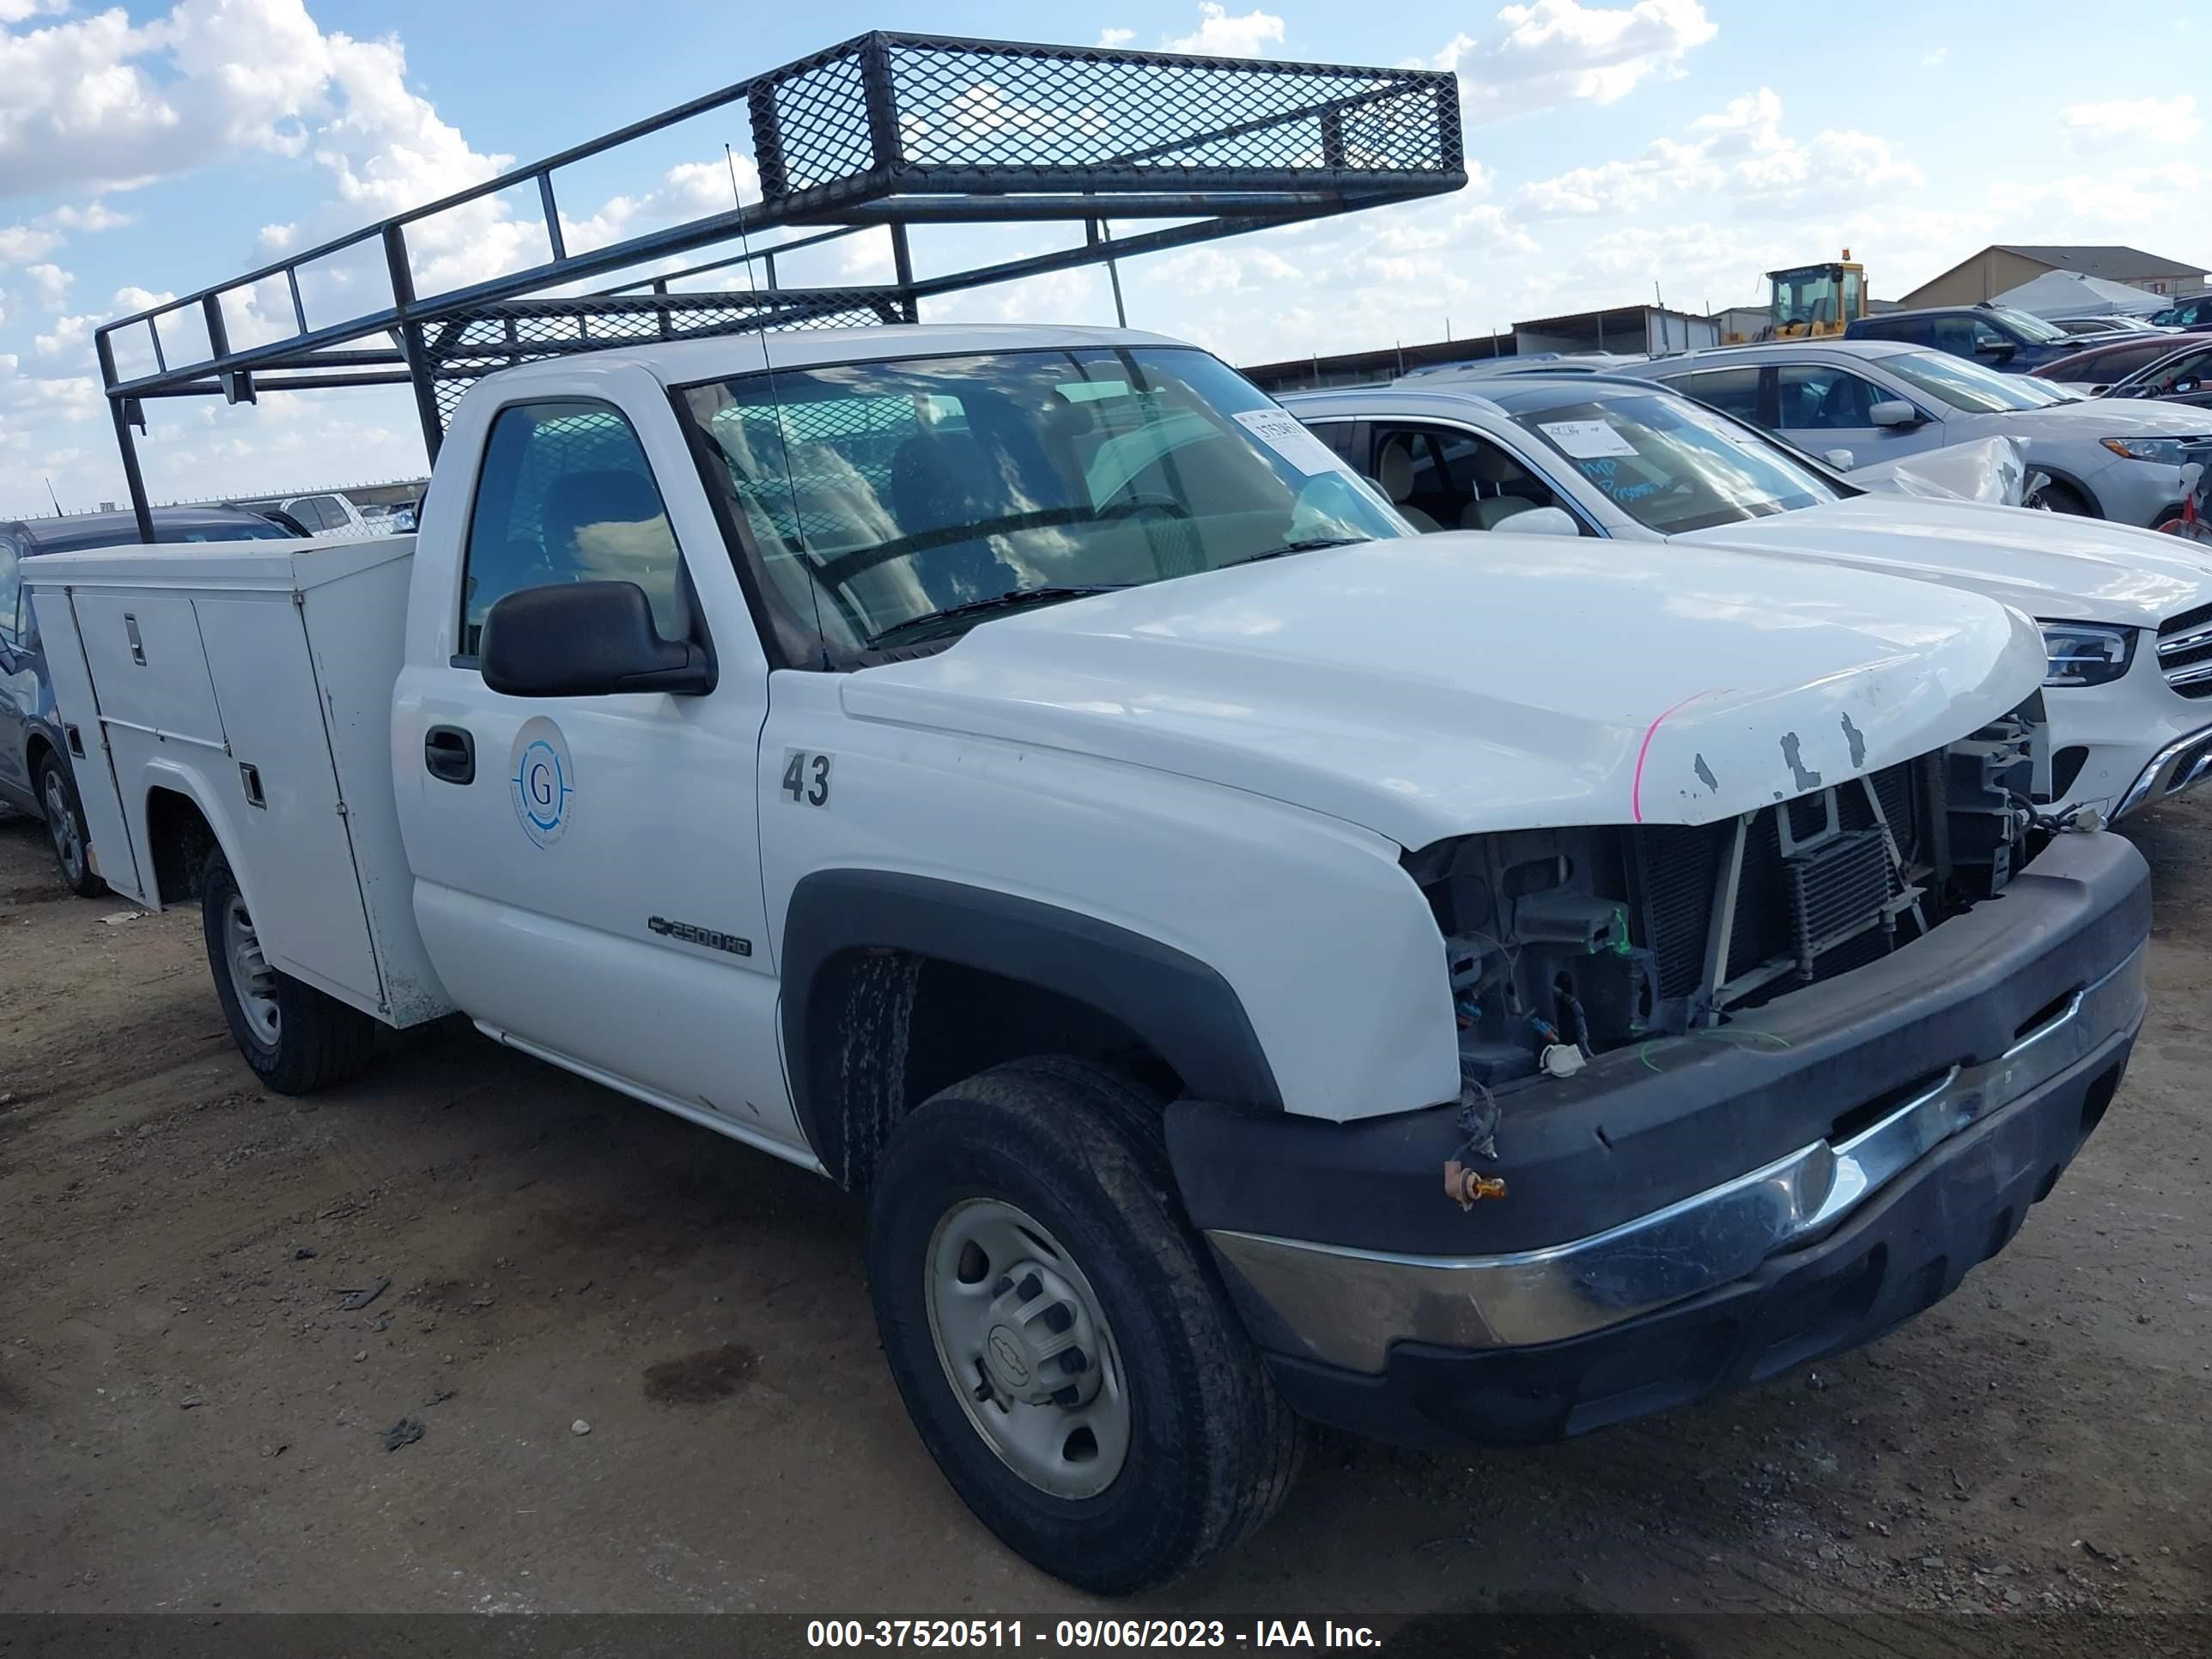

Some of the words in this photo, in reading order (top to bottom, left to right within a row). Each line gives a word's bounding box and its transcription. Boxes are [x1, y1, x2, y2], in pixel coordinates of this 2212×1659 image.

[531, 763, 551, 805] G
[782, 752, 830, 807] 43
[672, 921, 723, 951] 2500
[726, 936, 750, 955] HD
